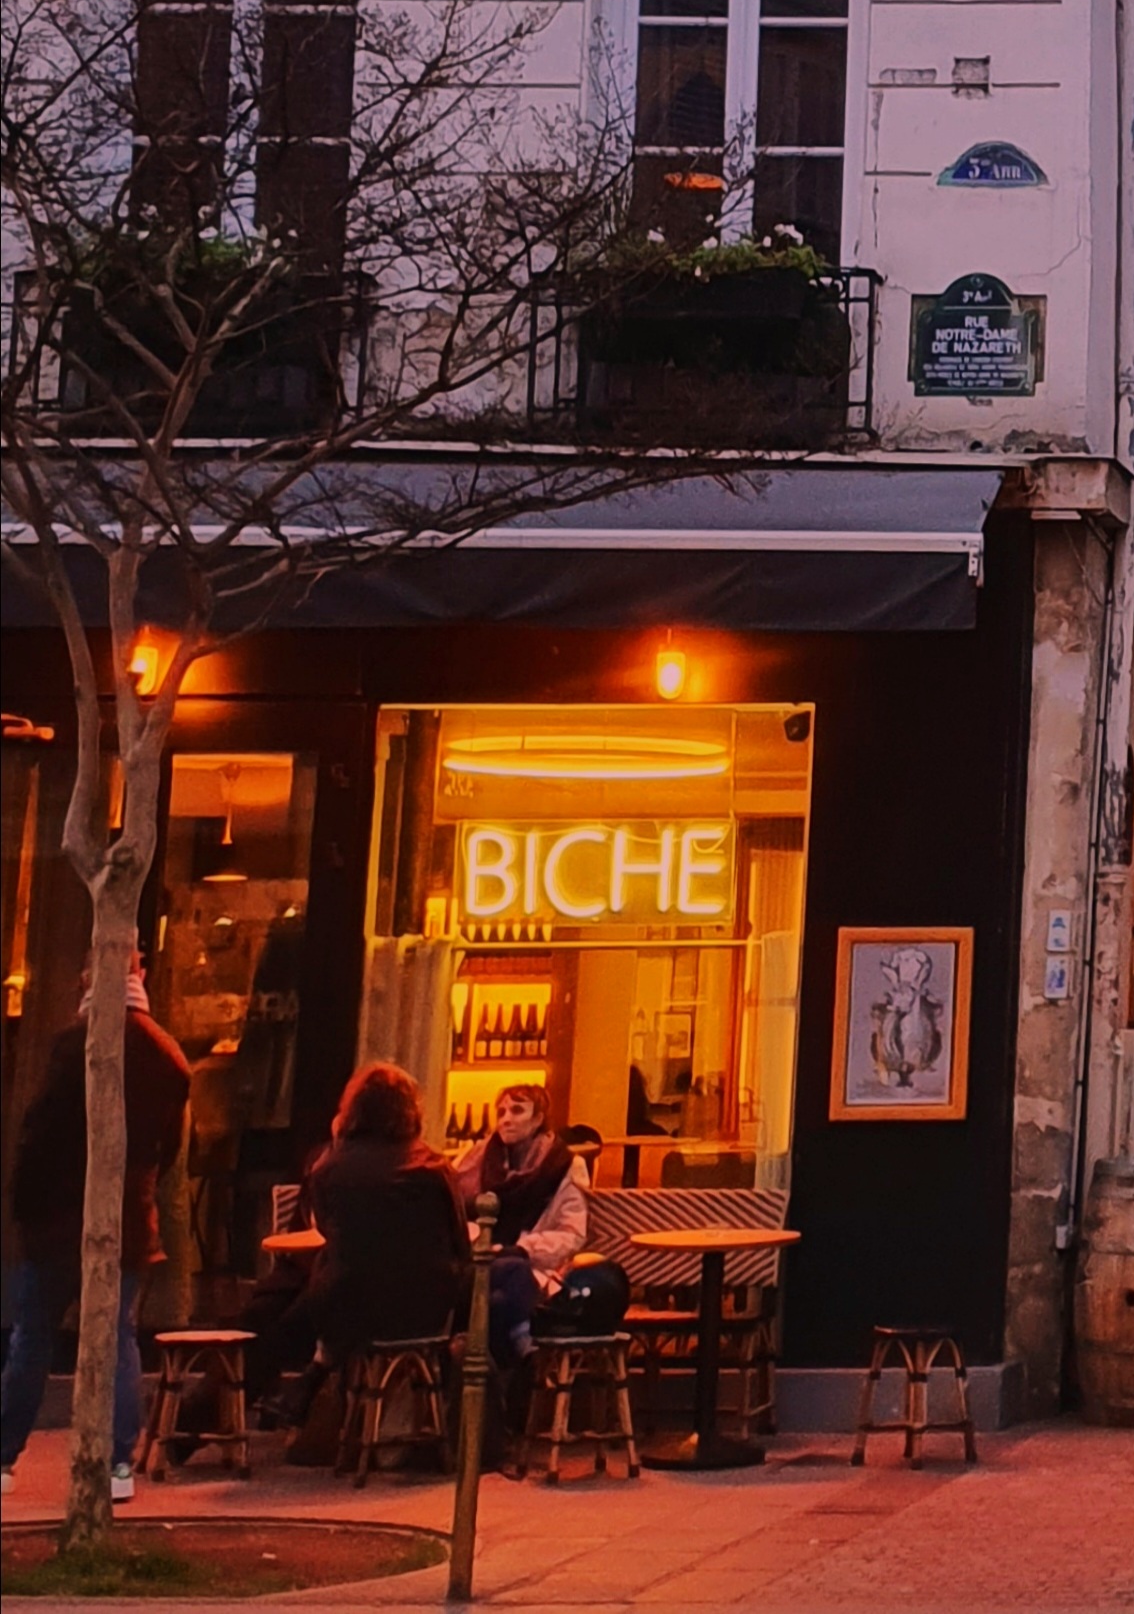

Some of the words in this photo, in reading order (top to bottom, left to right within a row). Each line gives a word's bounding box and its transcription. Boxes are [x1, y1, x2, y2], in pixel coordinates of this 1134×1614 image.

[965, 316, 989, 328] RUE
[935, 328, 1018, 341] NOTRE-DAME
[932, 342, 948, 354] DE
[953, 342, 1022, 354] NAZARETH
[463, 827, 729, 918] BICHE
